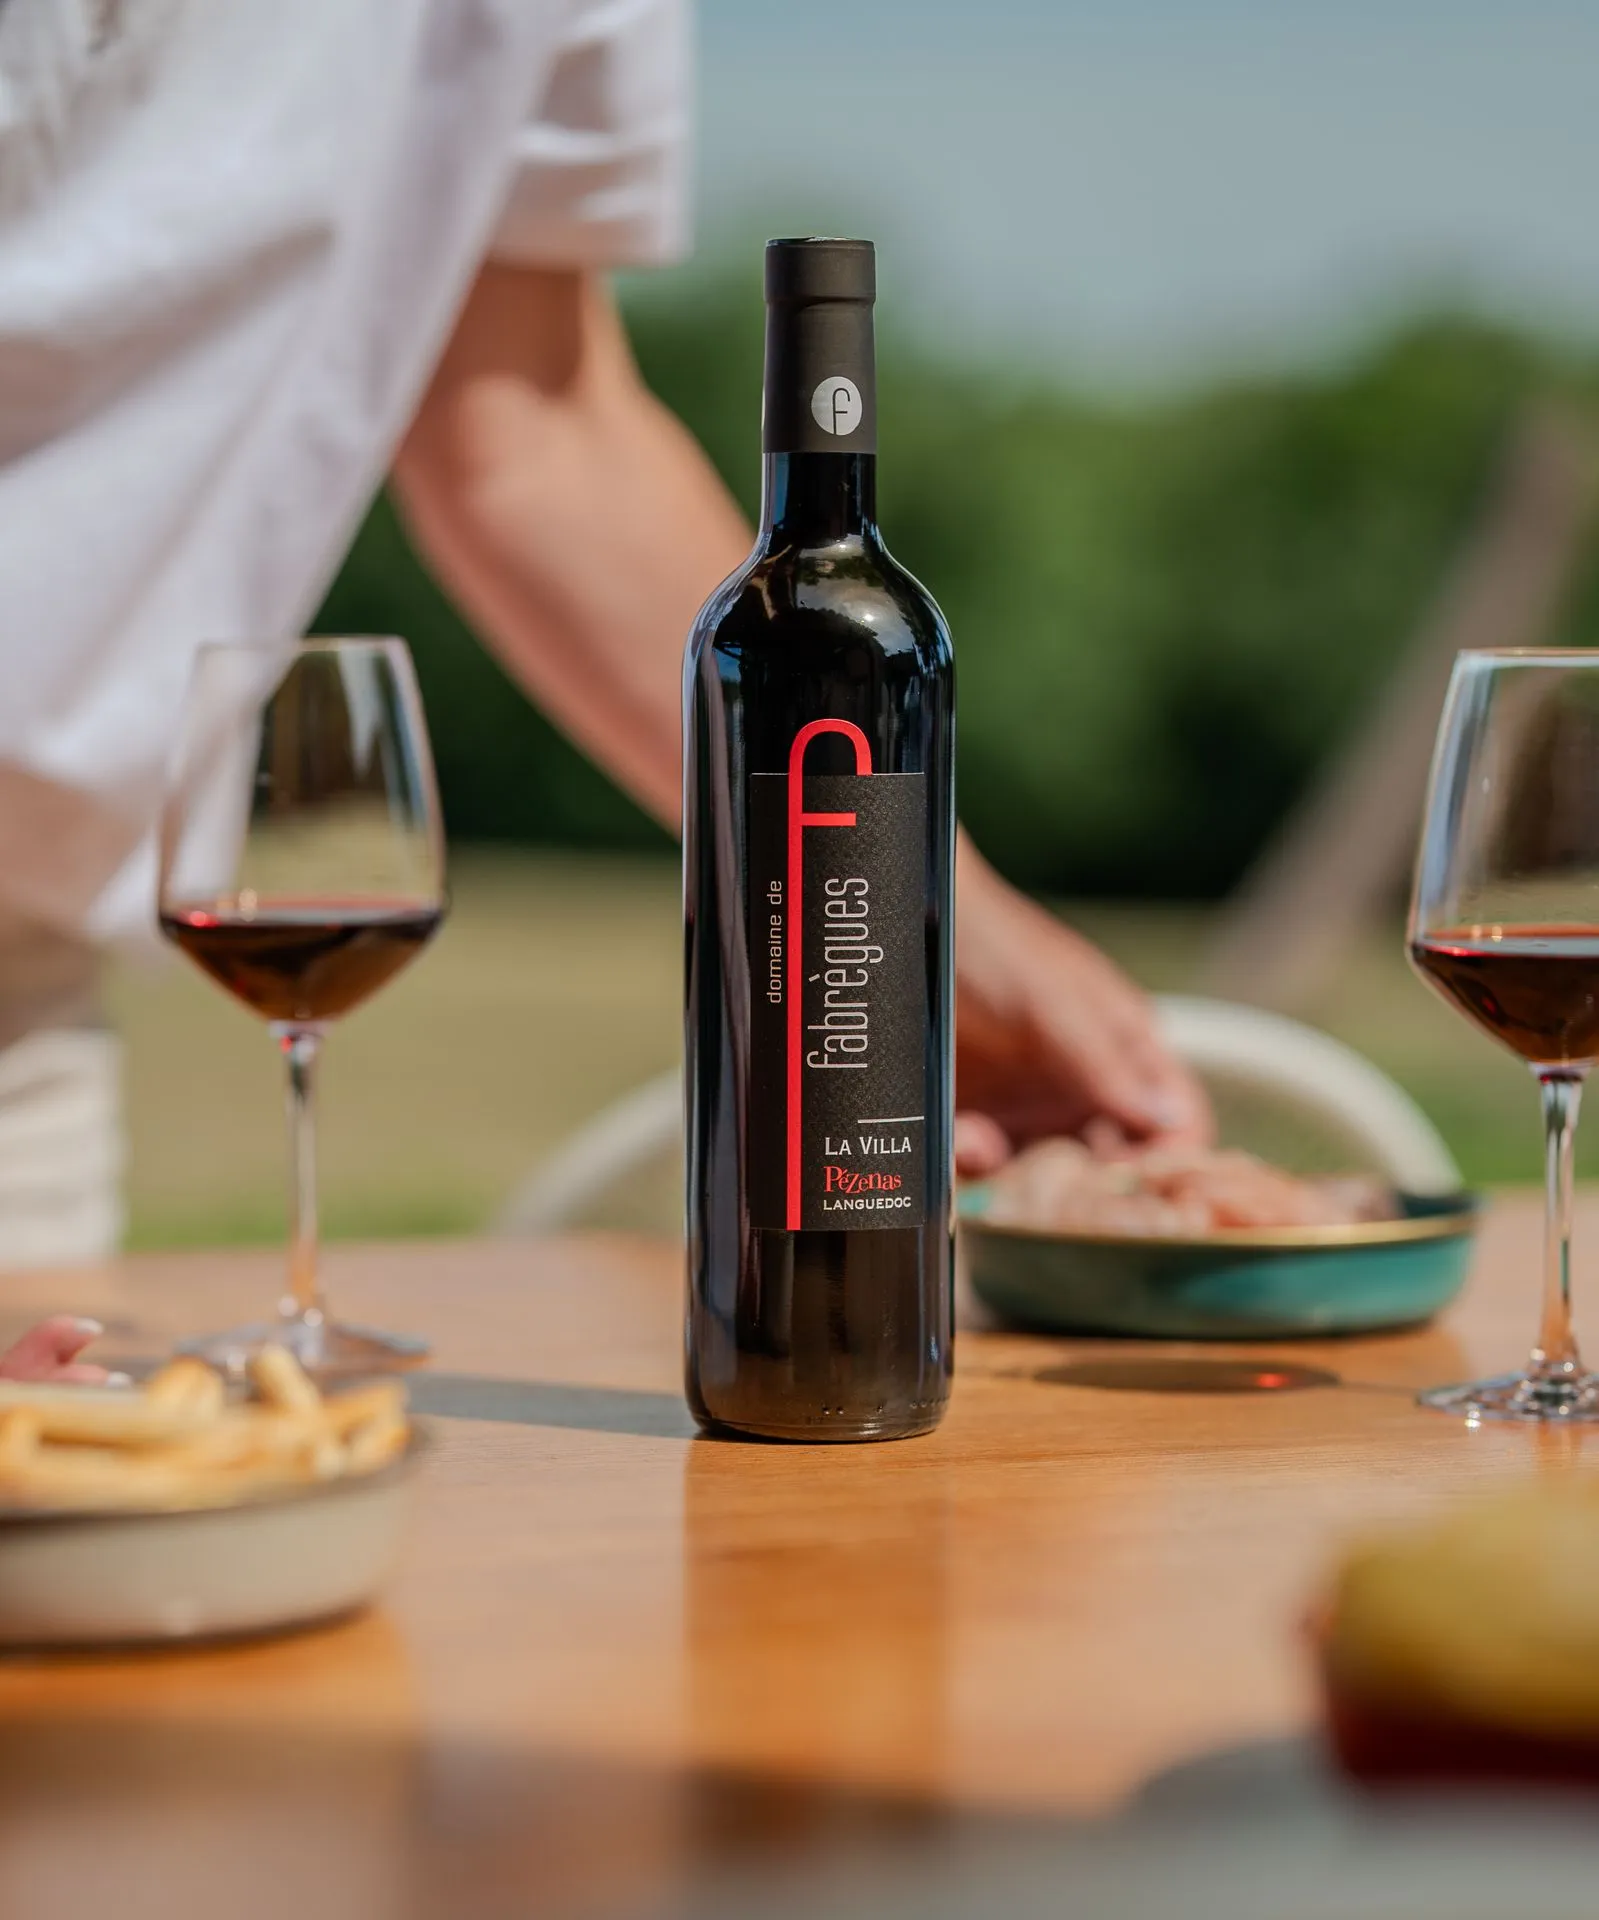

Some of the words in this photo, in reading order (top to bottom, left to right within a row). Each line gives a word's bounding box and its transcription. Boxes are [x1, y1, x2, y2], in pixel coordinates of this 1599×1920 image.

[766, 879, 782, 905] de
[766, 914, 782, 1004] domaine
[806, 878, 884, 1069] fabrègues
[825, 1137, 852, 1155] LA
[859, 1136, 912, 1154] VILLA
[823, 1197, 911, 1210] LANGUEDOC
